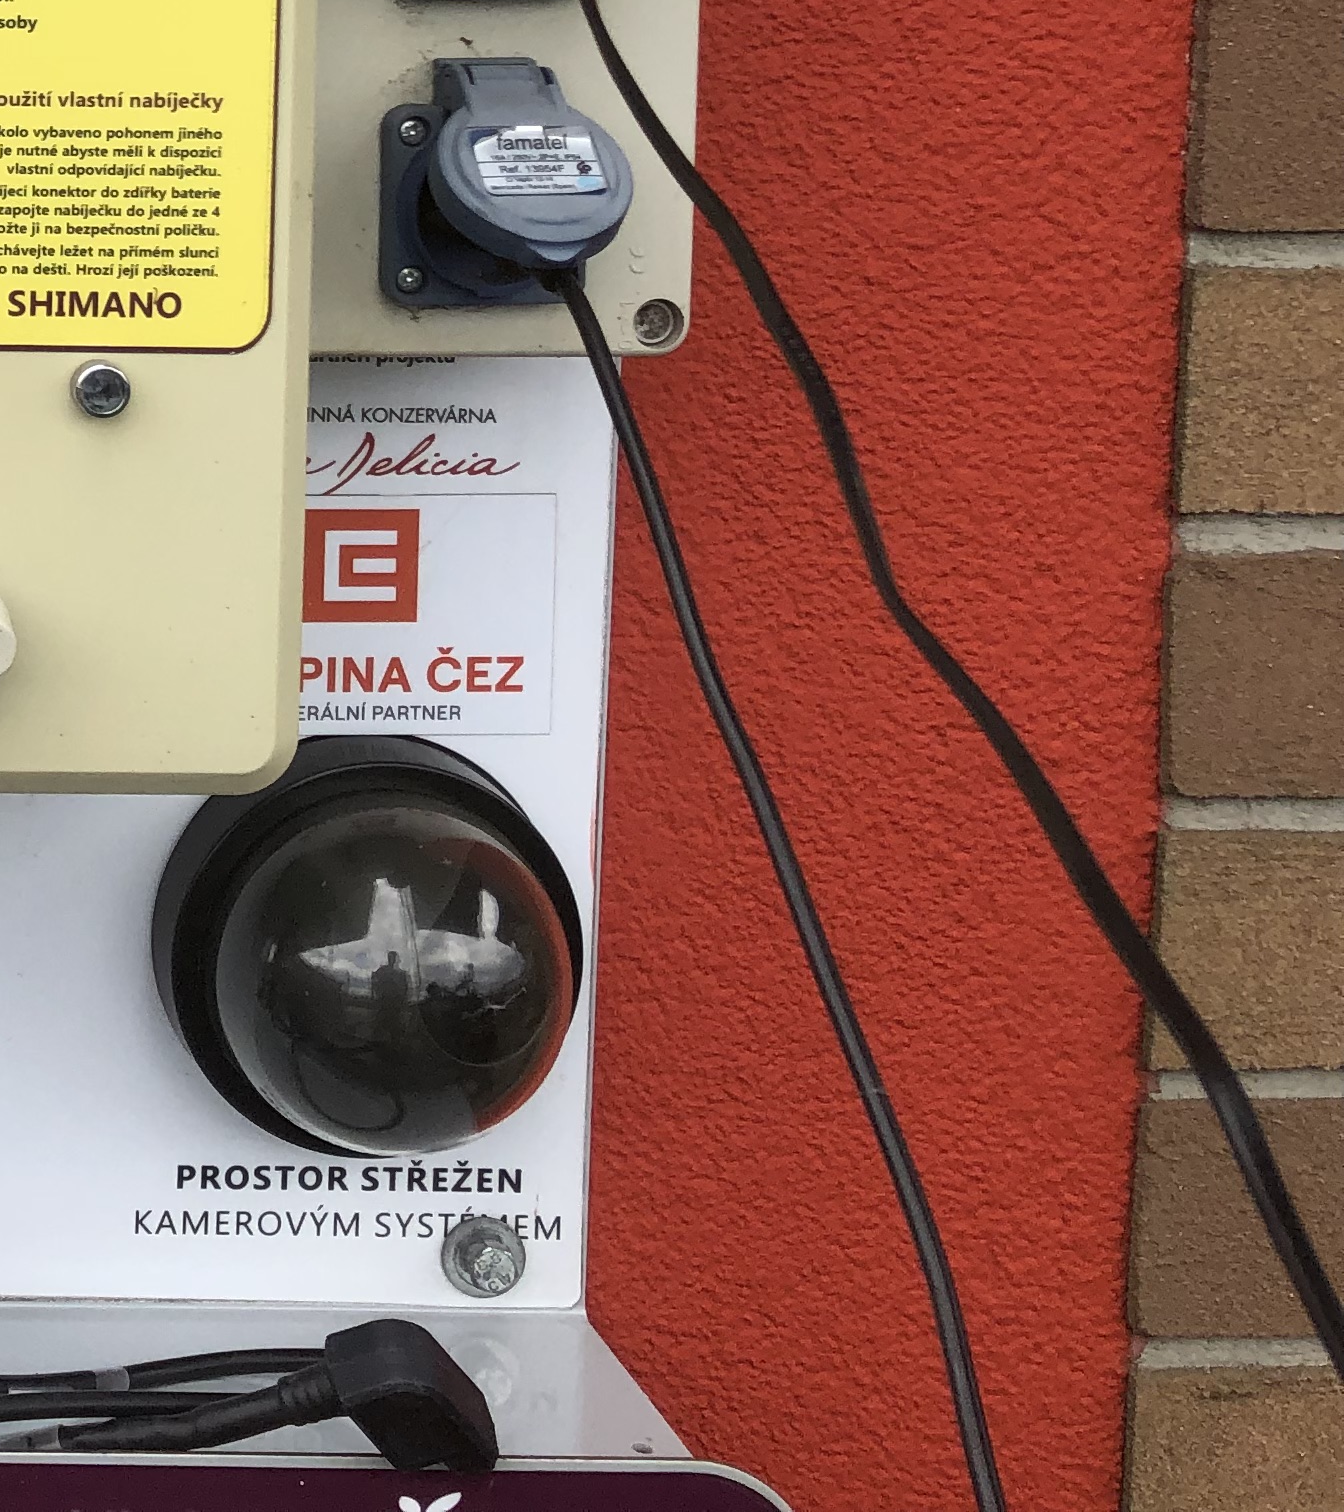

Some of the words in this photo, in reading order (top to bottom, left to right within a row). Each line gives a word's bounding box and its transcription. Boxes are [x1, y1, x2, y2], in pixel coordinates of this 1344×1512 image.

[57, 90, 124, 108] vlastní
[129, 91, 224, 114] nabíječky
[496, 132, 569, 151] famatel
[7, 289, 182, 319] SHIMANO
[360, 404, 497, 424] KONZERVÁRNA
[426, 646, 525, 693] ČEZ
[372, 705, 461, 722] PARTNER
[176, 1164, 349, 1191] PROSTOR
[361, 1160, 523, 1194] STŘEŽEN
[134, 1204, 360, 1238] KAMEROVÝM
[374, 1207, 562, 1241] SYSTEM
